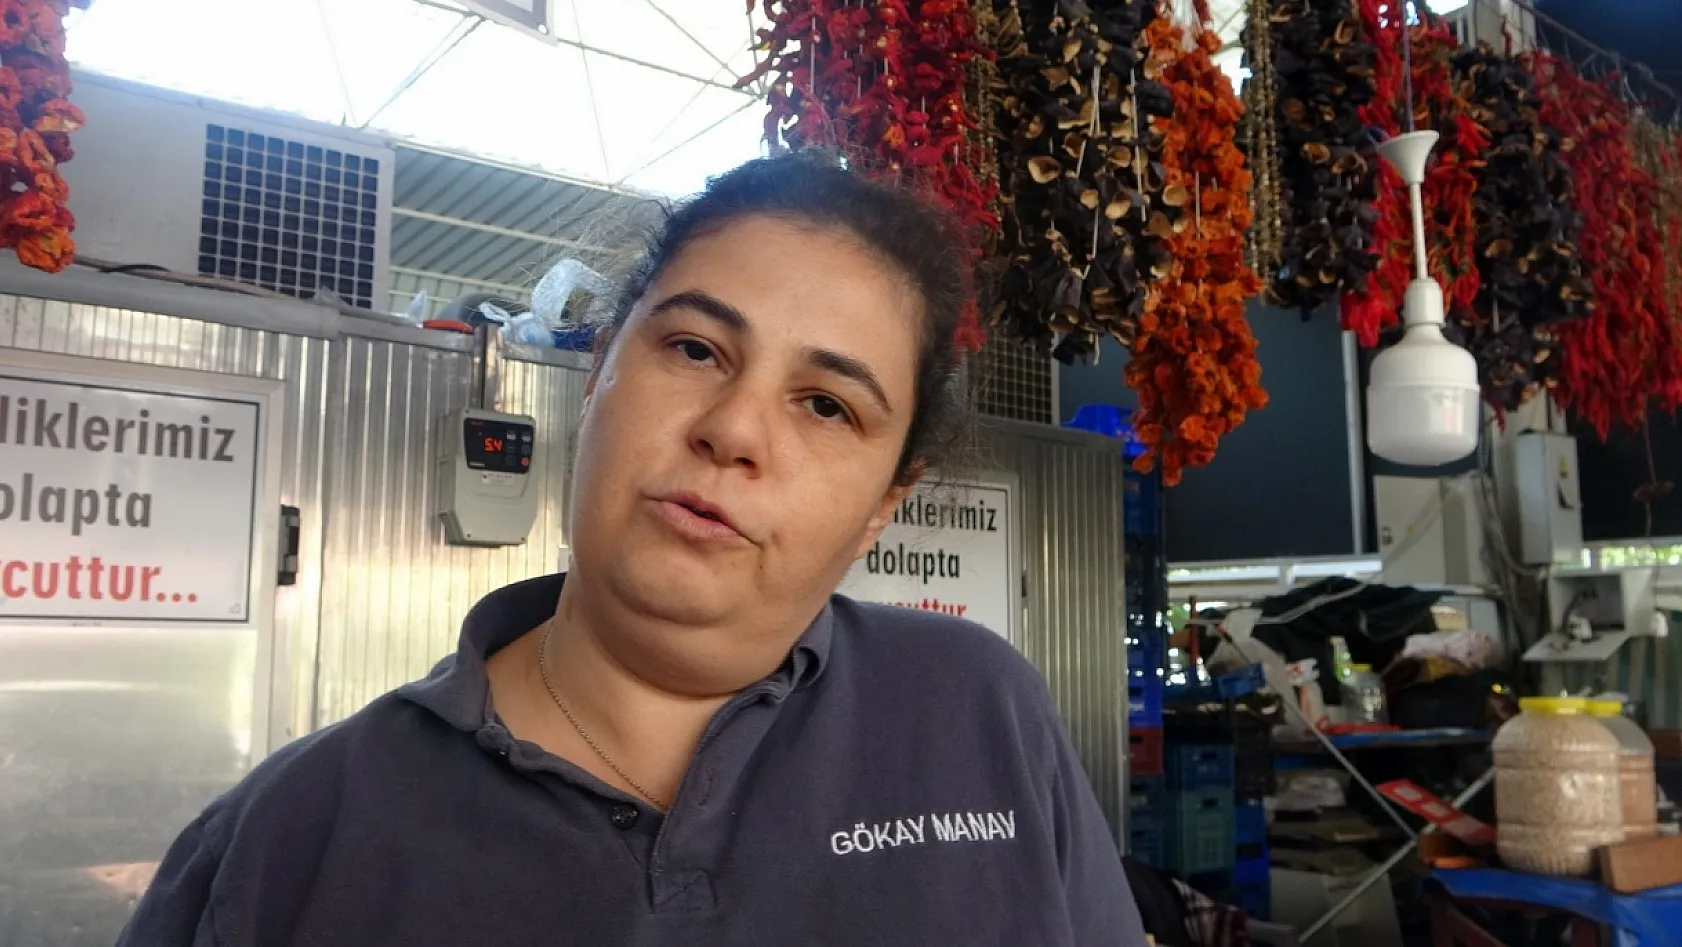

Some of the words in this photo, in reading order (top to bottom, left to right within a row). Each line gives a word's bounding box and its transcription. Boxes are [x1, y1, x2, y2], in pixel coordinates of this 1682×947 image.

[0, 556, 198, 603] cuttur...
[867, 541, 960, 585] dolapta
[830, 815, 925, 855] GÖKAY
[931, 810, 1016, 842] MANAV
